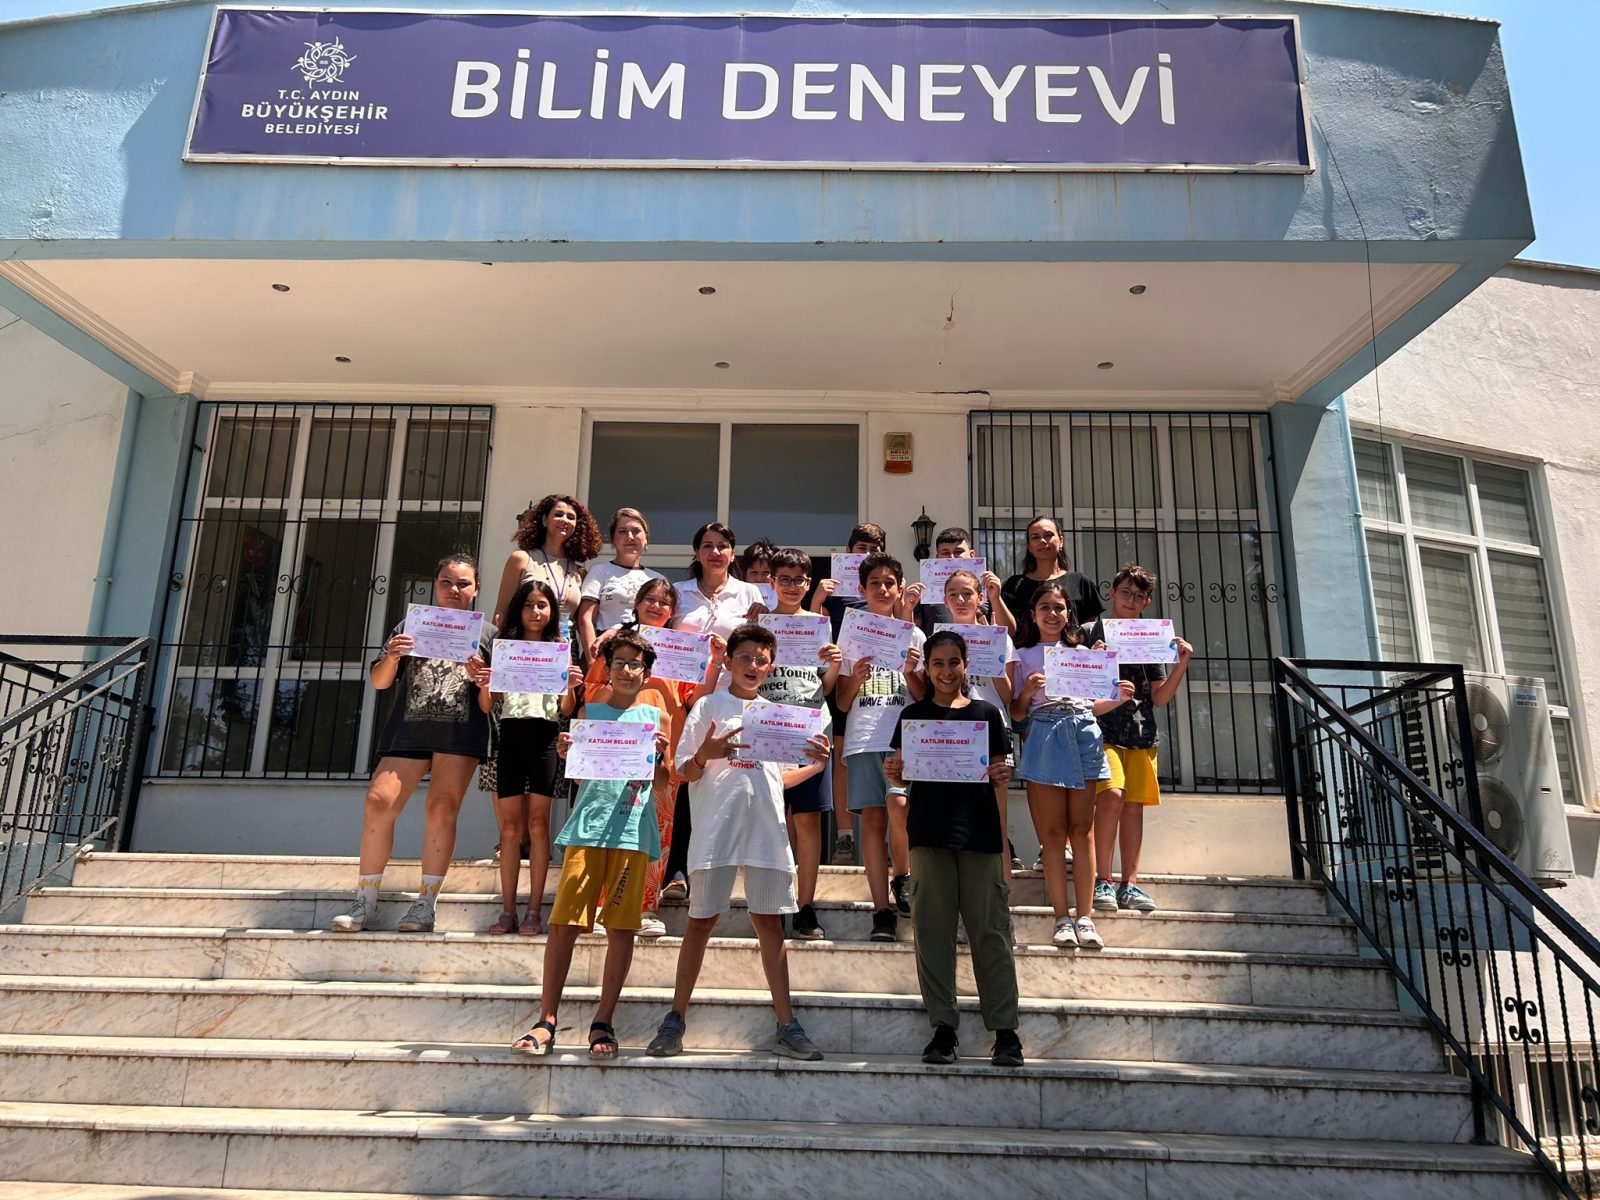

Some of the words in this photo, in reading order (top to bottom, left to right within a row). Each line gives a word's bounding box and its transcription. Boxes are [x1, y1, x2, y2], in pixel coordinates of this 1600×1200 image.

[451, 48, 686, 120] BİLİM
[721, 52, 1176, 126] DENEYEVİ
[278, 89, 304, 100] T.C.
[310, 90, 360, 101] AYDIN
[241, 102, 388, 122] BÜYÜKŞEHİR
[264, 123, 360, 135] BELEDİYESİ
[859, 696, 883, 707] WAVE
[885, 696, 905, 706] KING
